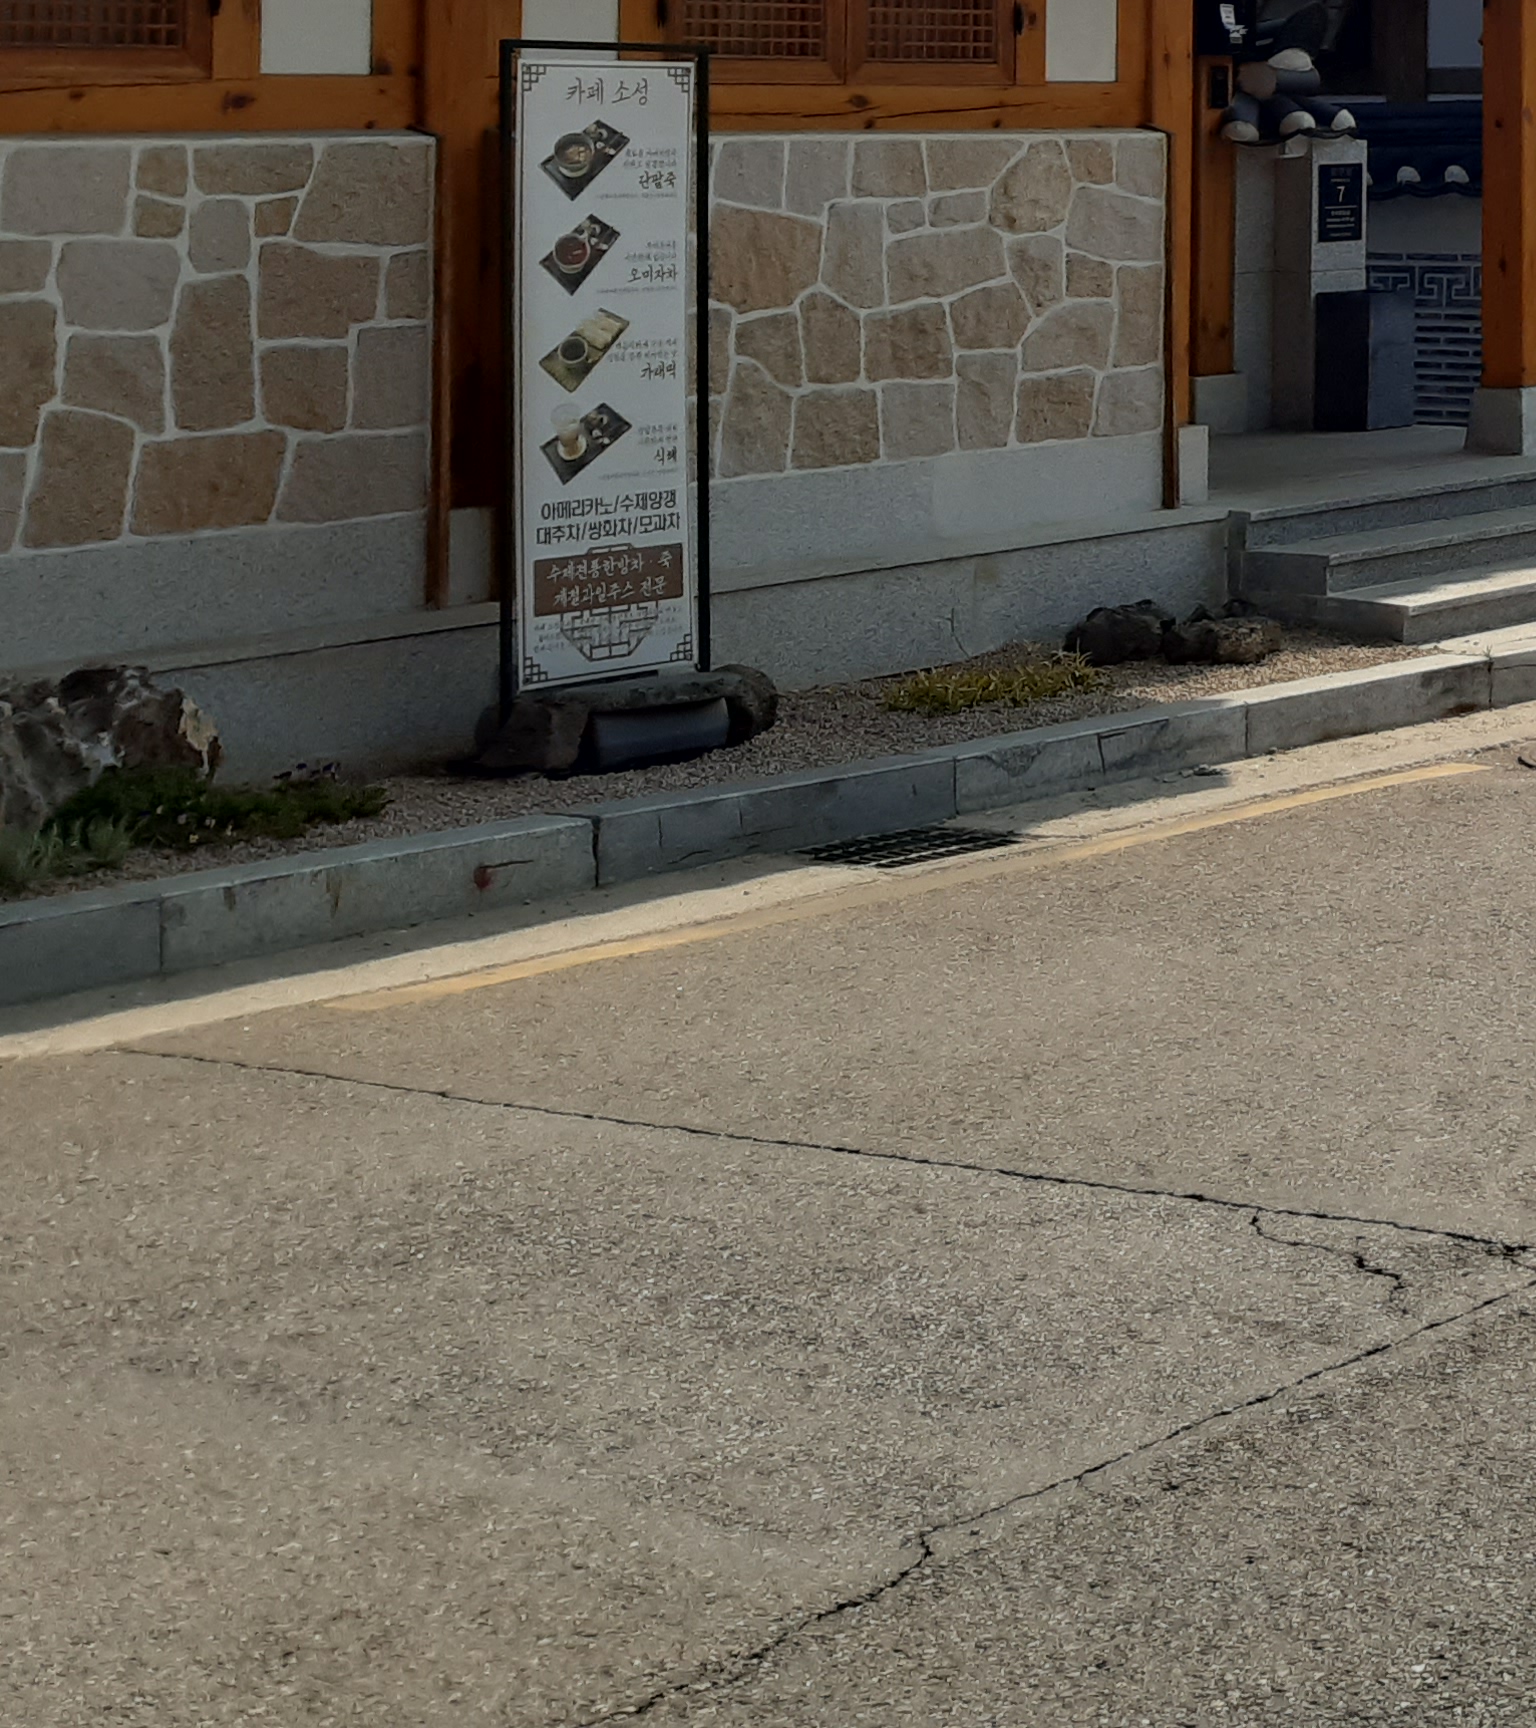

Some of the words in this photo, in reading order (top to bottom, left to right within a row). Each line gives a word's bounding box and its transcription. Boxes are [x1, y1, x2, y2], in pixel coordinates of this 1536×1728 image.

[565, 76, 605, 105] 카페
[611, 77, 650, 106] 소성
[1336, 185, 1346, 202] 7
[627, 263, 678, 284] 오미자차
[640, 360, 677, 381] 가래떡
